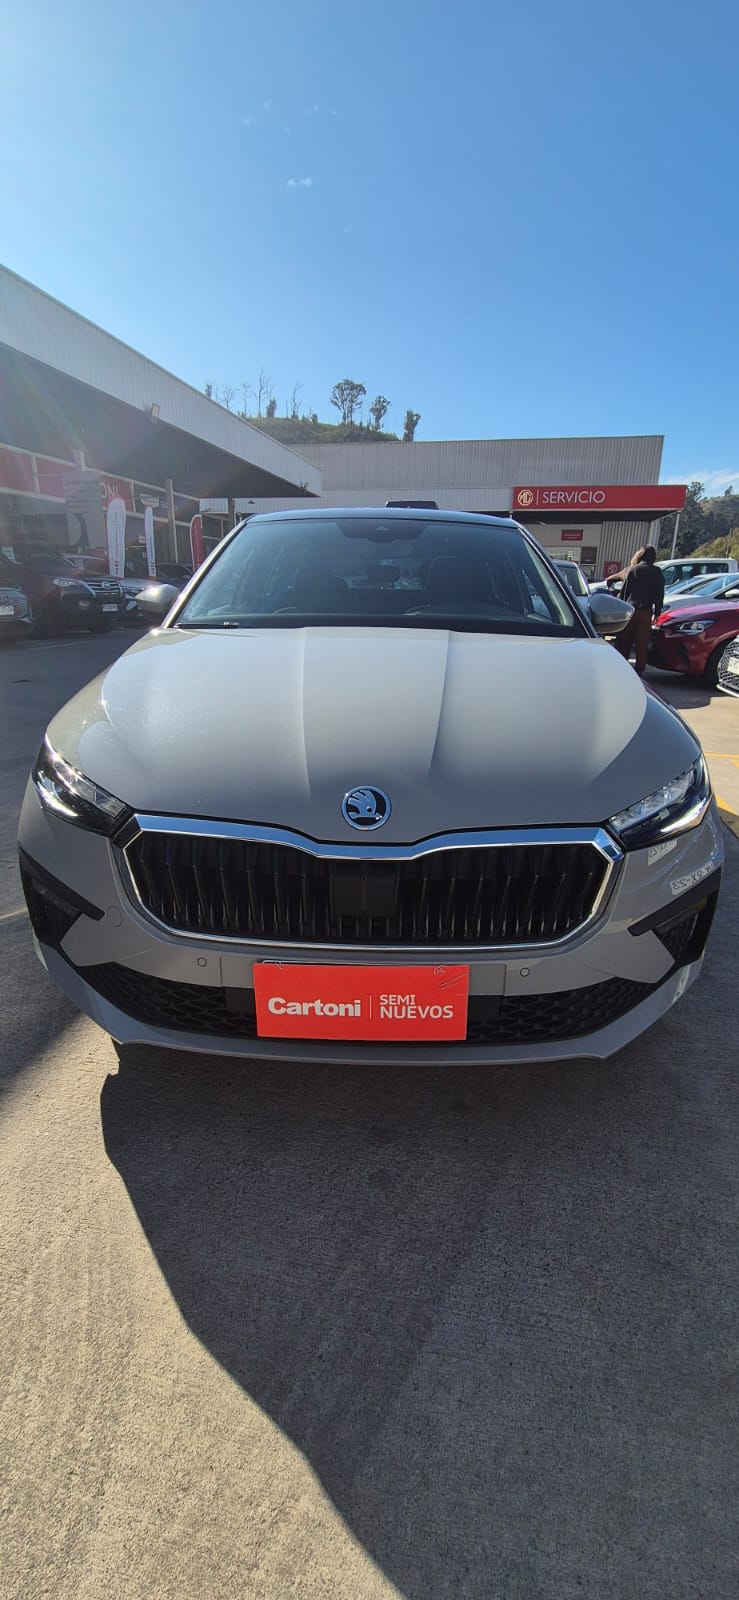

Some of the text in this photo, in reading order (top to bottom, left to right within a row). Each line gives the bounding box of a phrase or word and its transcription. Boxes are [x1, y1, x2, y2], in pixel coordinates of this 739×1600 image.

[542, 490, 606, 504] SERVICIO
[267, 997, 361, 1017] Cartoni
[379, 994, 416, 1006] SEMI
[379, 1005, 454, 1019] NUEVOS
